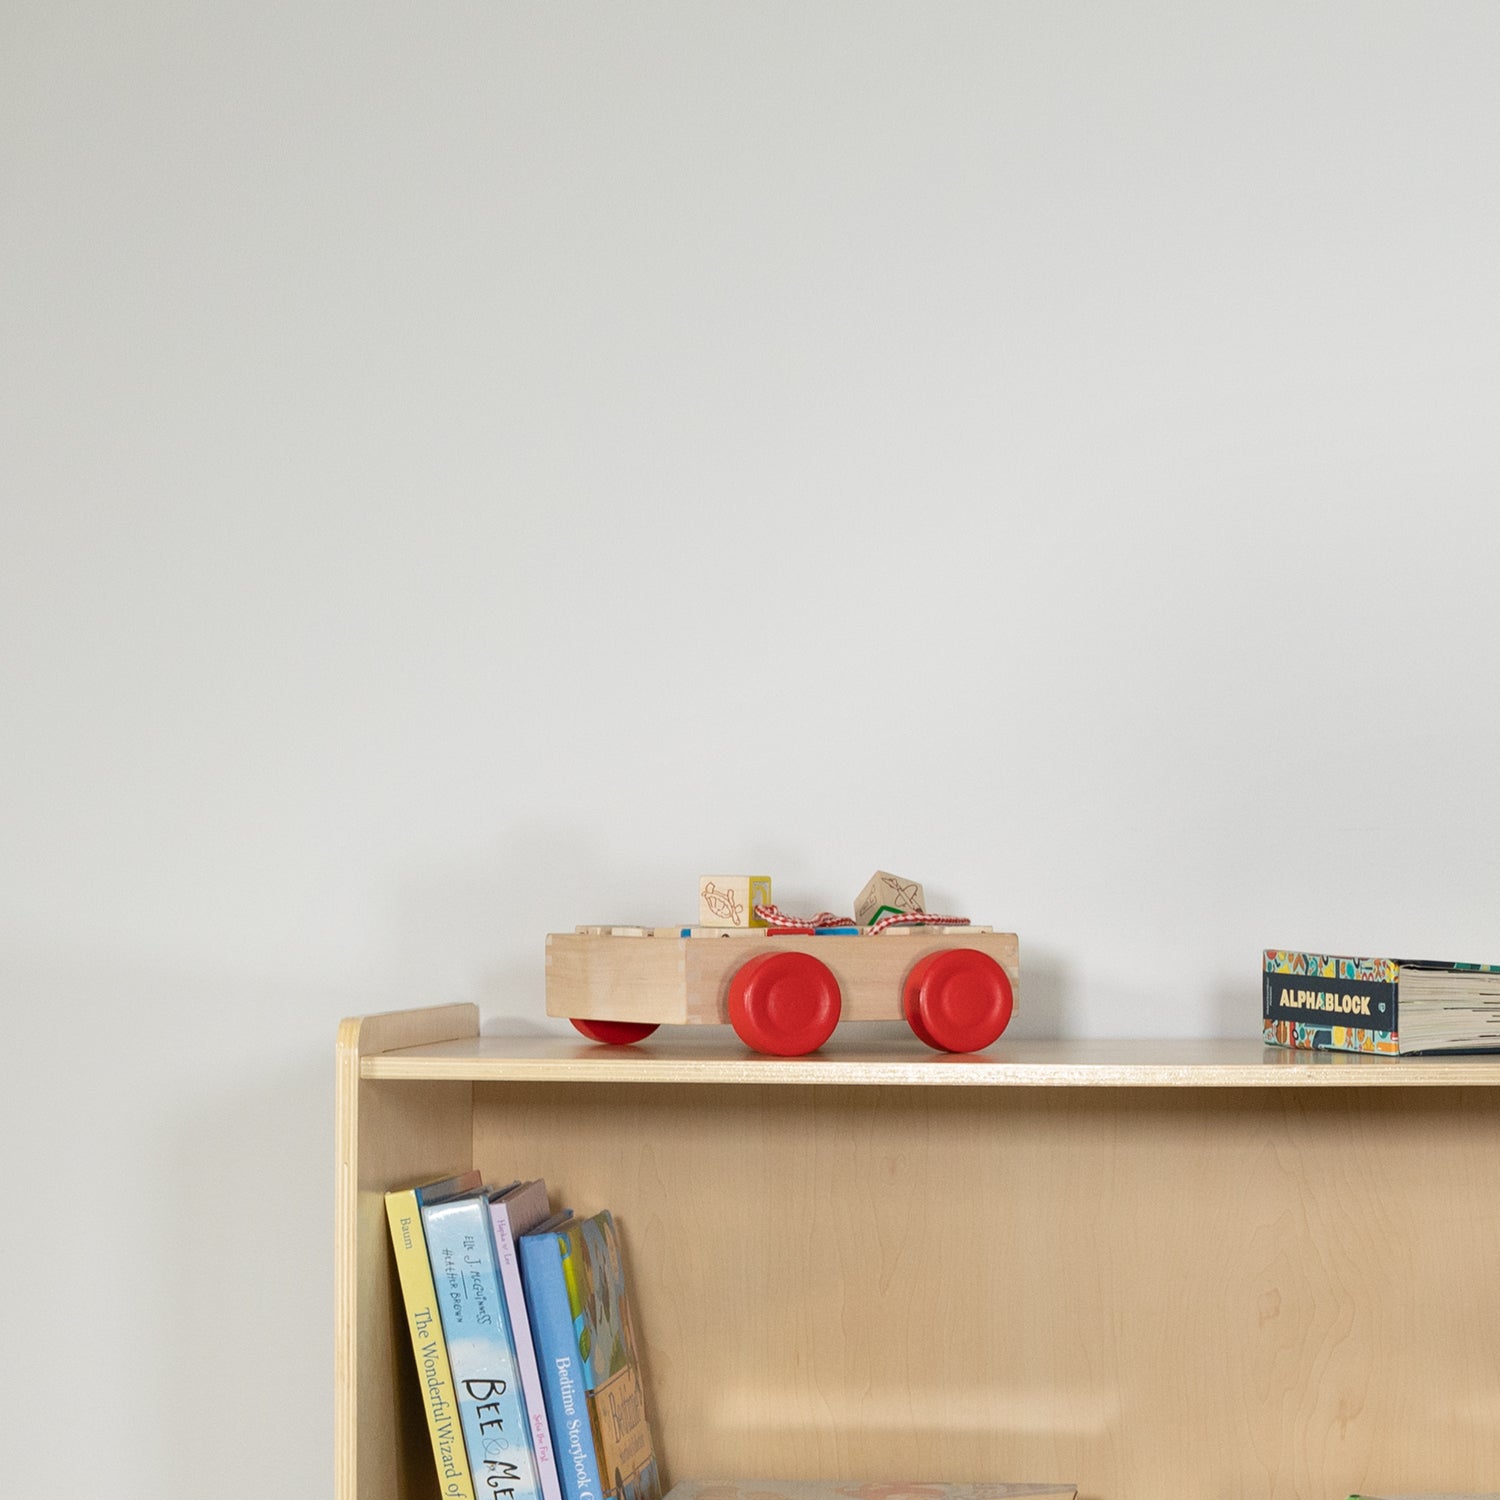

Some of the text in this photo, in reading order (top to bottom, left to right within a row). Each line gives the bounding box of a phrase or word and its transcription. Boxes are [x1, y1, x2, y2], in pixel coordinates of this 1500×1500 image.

[1280, 988, 1371, 1017] ALPHABLOCK
[400, 1217, 413, 1250] Baum
[414, 1307, 433, 1338] The
[422, 1341, 450, 1422] Wonderful
[461, 1379, 507, 1436] BEE
[555, 1356, 576, 1416] Bedtime
[566, 1419, 591, 1488] Storybook
[436, 1422, 462, 1479] Wizard
[445, 1483, 467, 1498] of
